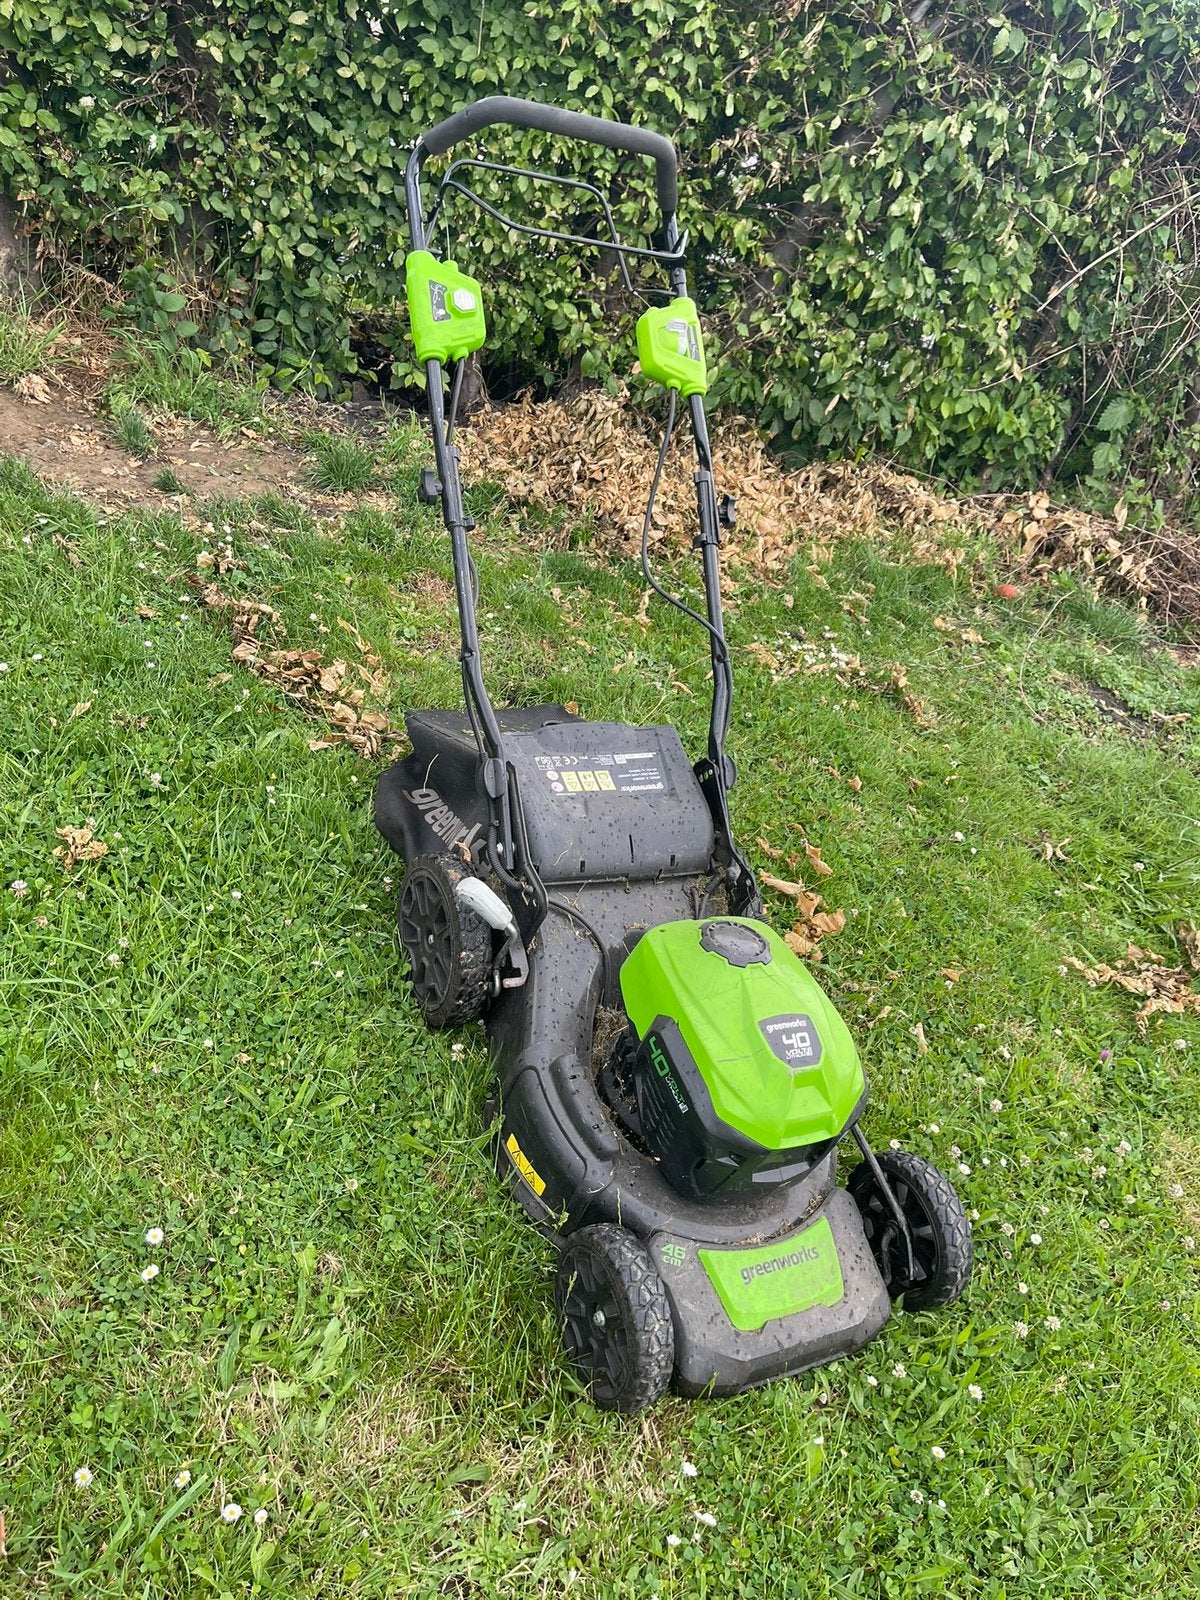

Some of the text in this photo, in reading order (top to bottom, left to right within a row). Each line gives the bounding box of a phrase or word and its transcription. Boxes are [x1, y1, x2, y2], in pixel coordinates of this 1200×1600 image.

[620, 782, 664, 793] greenworks
[766, 1019, 807, 1033] greenworks
[782, 1031, 811, 1049] 40
[785, 1047, 807, 1057] VOLT
[649, 1036, 685, 1103] 40 VOLT
[661, 1243, 686, 1260] 46
[663, 1254, 682, 1267] cm
[740, 1246, 820, 1285] greenworks
